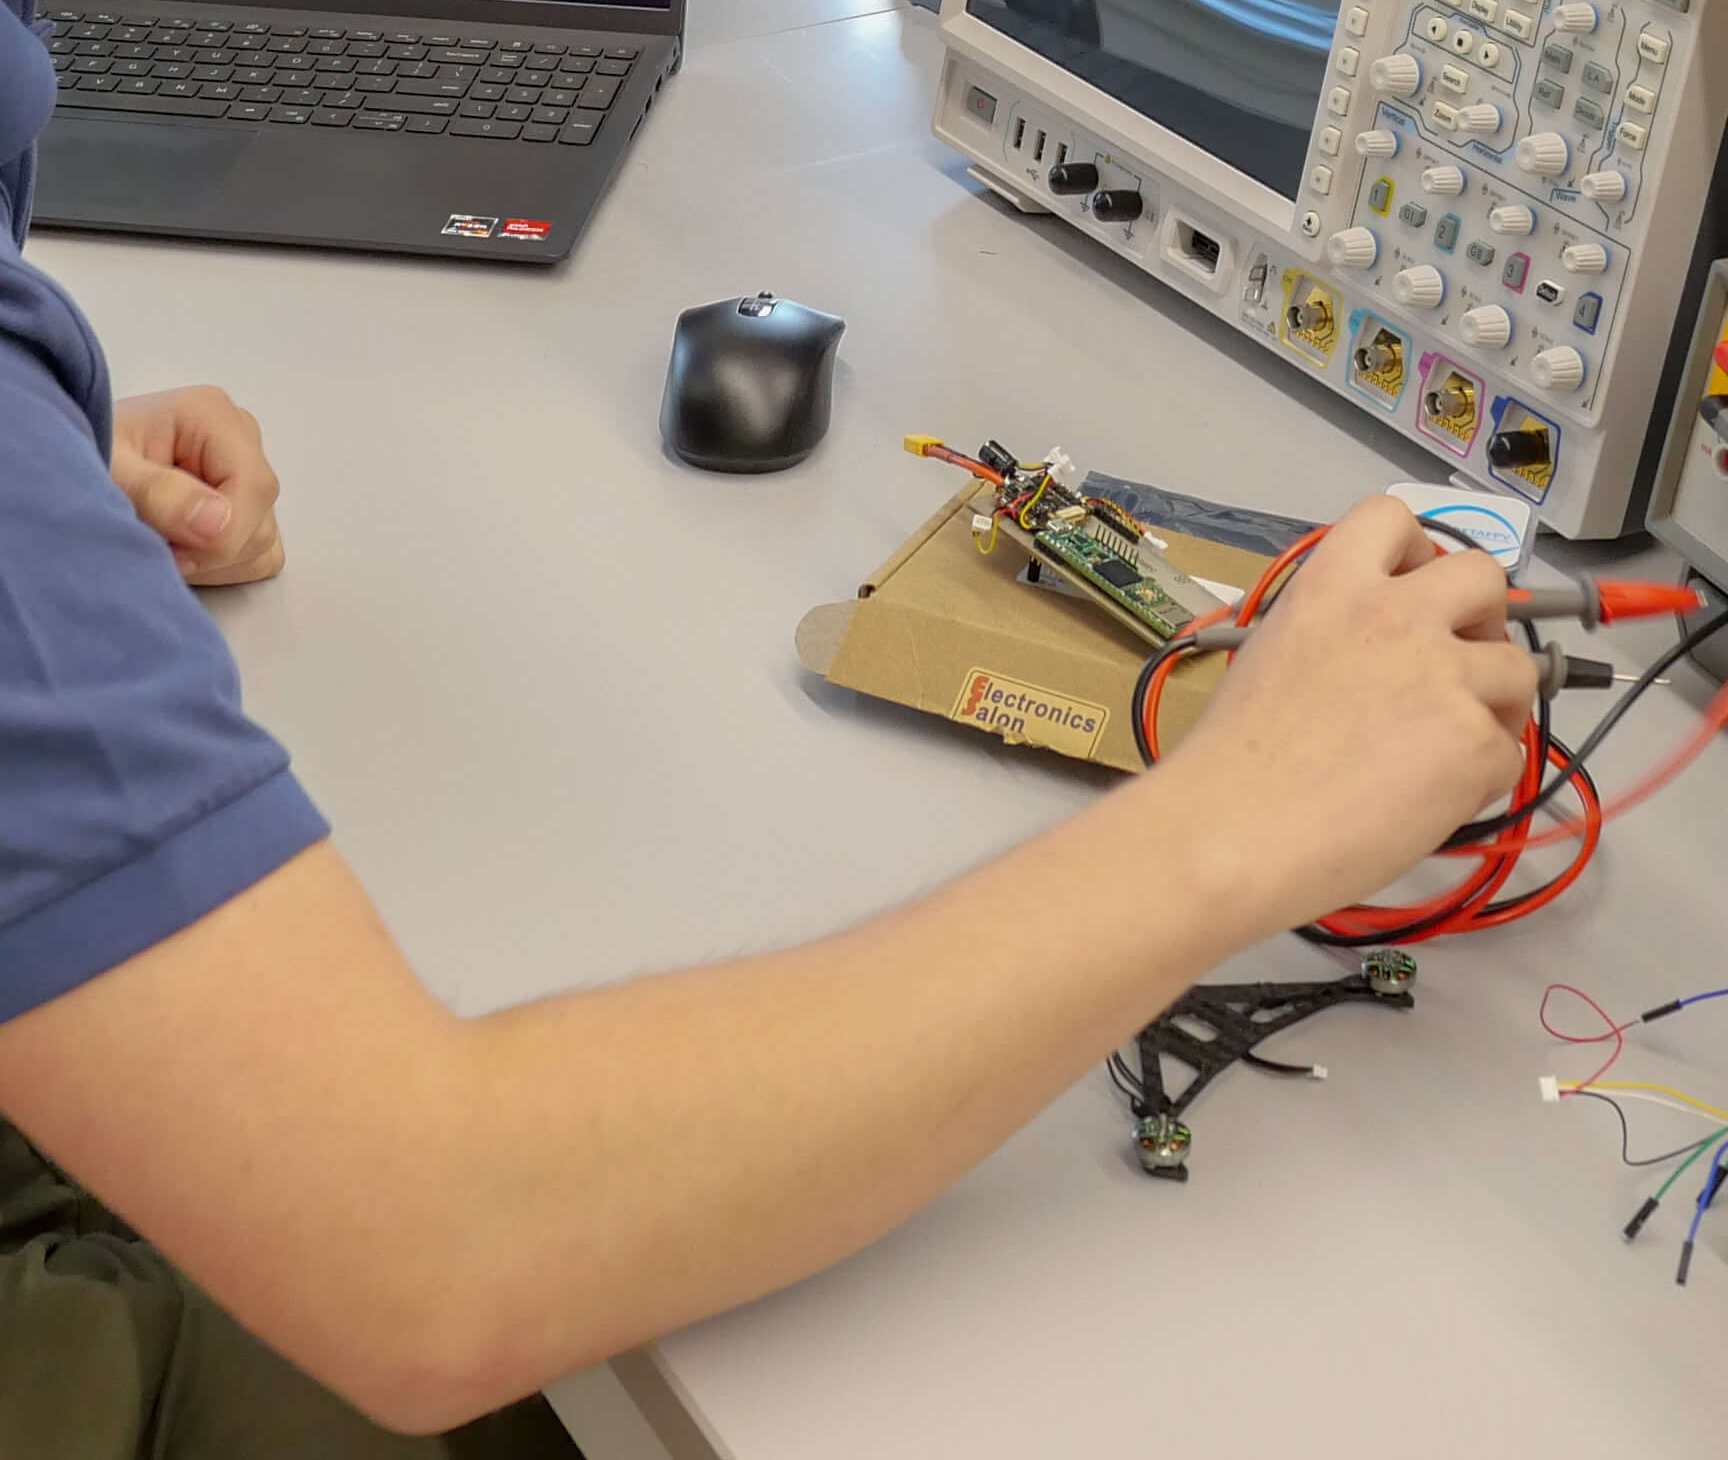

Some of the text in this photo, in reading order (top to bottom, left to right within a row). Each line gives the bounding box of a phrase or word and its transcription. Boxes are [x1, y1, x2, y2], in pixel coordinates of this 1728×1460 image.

[1640, 41, 1659, 58] Menu
[1442, 69, 1461, 87] Search
[1628, 91, 1646, 106] Mode
[1381, 104, 1407, 127] Vertical
[1433, 107, 1452, 123] Zoom
[1619, 126, 1638, 142] Force
[1437, 224, 1447, 239] 2
[1506, 263, 1515, 278] 3
[1577, 304, 1586, 318] 4
[971, 675, 1097, 734] Electronics
